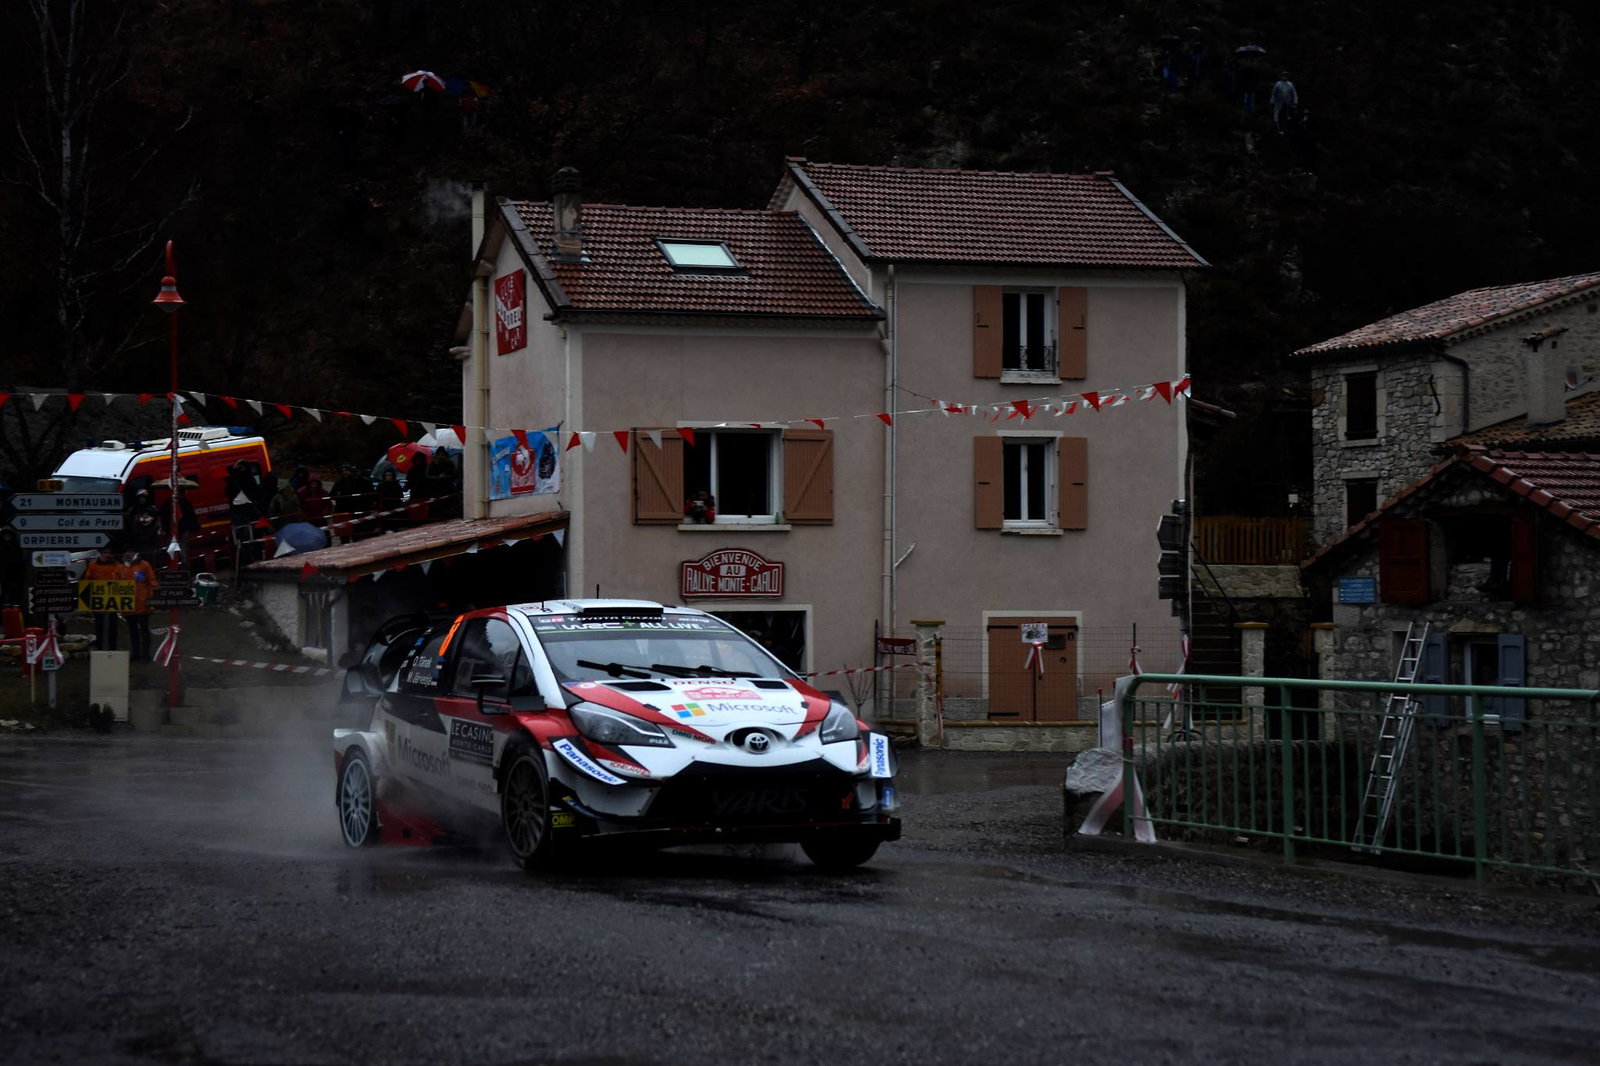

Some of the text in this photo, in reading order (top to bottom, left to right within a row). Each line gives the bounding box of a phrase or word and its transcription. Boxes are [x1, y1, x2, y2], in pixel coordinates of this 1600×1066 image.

[20, 498, 120, 507] 21 MONTAUBAN
[20, 518, 120, 528] 9 Col de Perty
[23, 536, 80, 545] ORPIERRE
[702, 553, 763, 571] BIENVENUE
[726, 566, 740, 575] AU
[687, 567, 716, 592] RALLYE
[92, 597, 133, 610] BAR
[668, 622, 703, 630] LIVE
[707, 701, 796, 714] Microsoft
[461, 724, 494, 744] CASINO
[672, 729, 692, 739] DMG
[398, 735, 448, 776] Microsoft
[560, 743, 618, 783] Panasonic
[711, 786, 808, 816] YARIS
[552, 815, 575, 825] OMP
